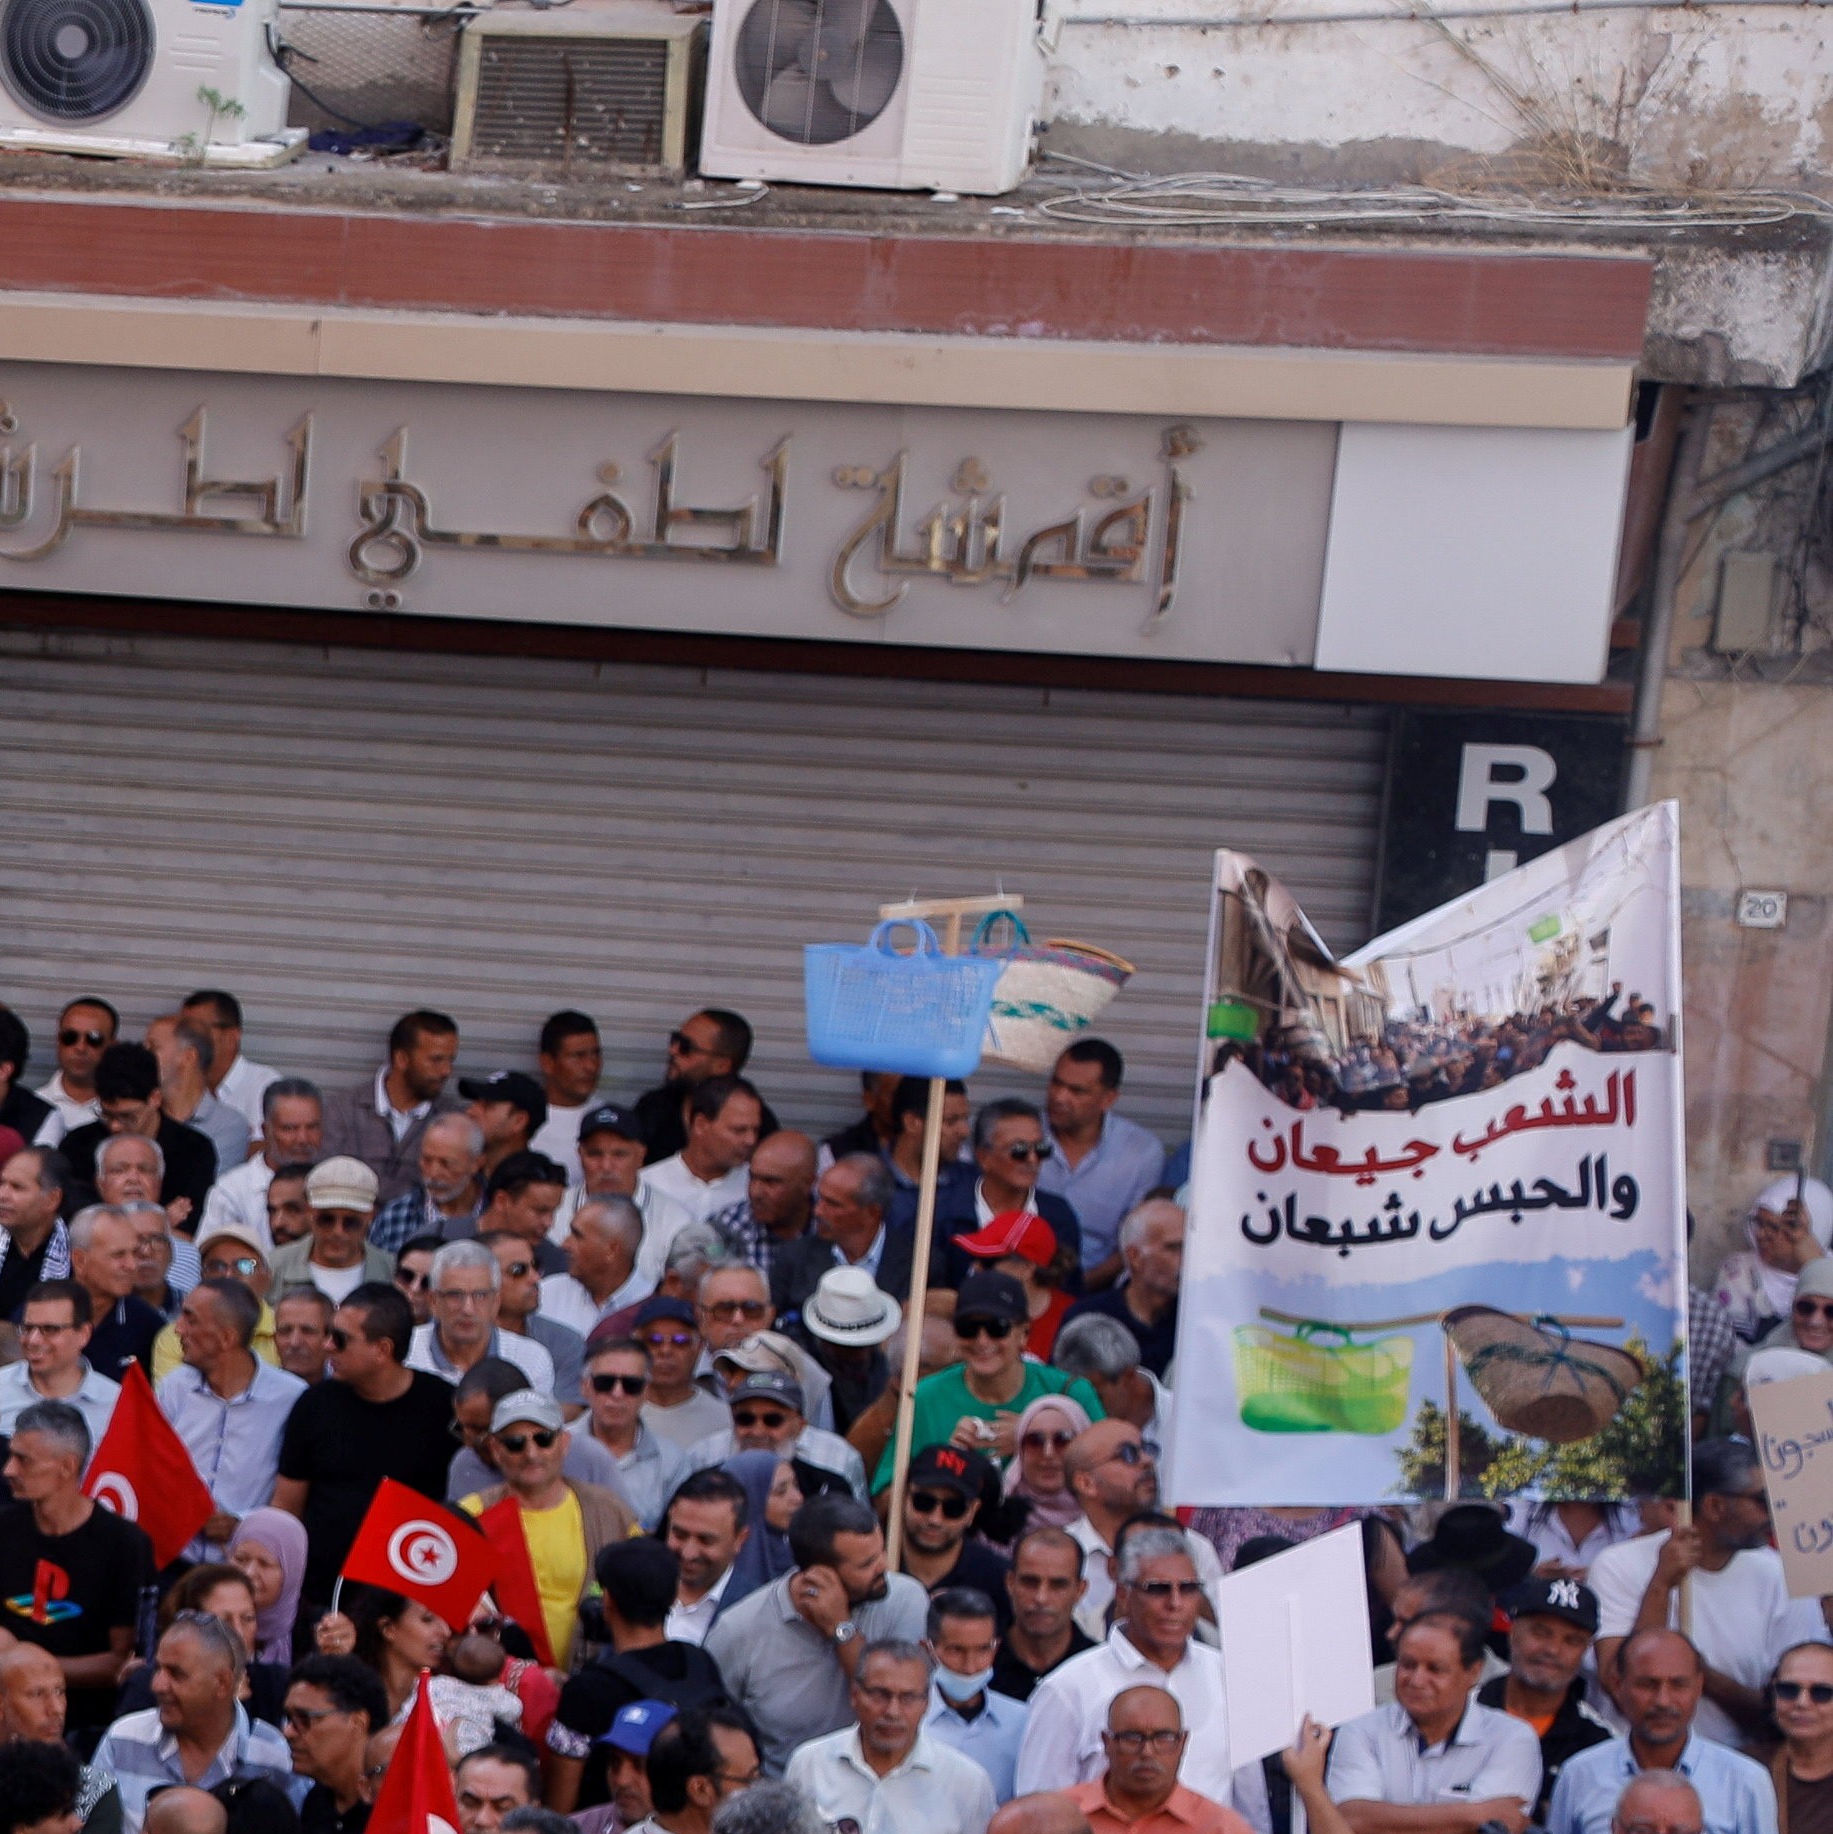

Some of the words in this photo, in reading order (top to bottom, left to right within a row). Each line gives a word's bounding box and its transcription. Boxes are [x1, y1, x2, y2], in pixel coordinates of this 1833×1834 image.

[343, 421, 800, 614] لطفي
[829, 421, 1201, 635] أقمشة
[1745, 899, 1778, 919] 20
[1247, 1116, 1440, 1188] جيعان
[1451, 1068, 1637, 1165] الشعب
[1239, 1190, 1420, 1257] شبعان
[1428, 1153, 1641, 1243] والحبس
